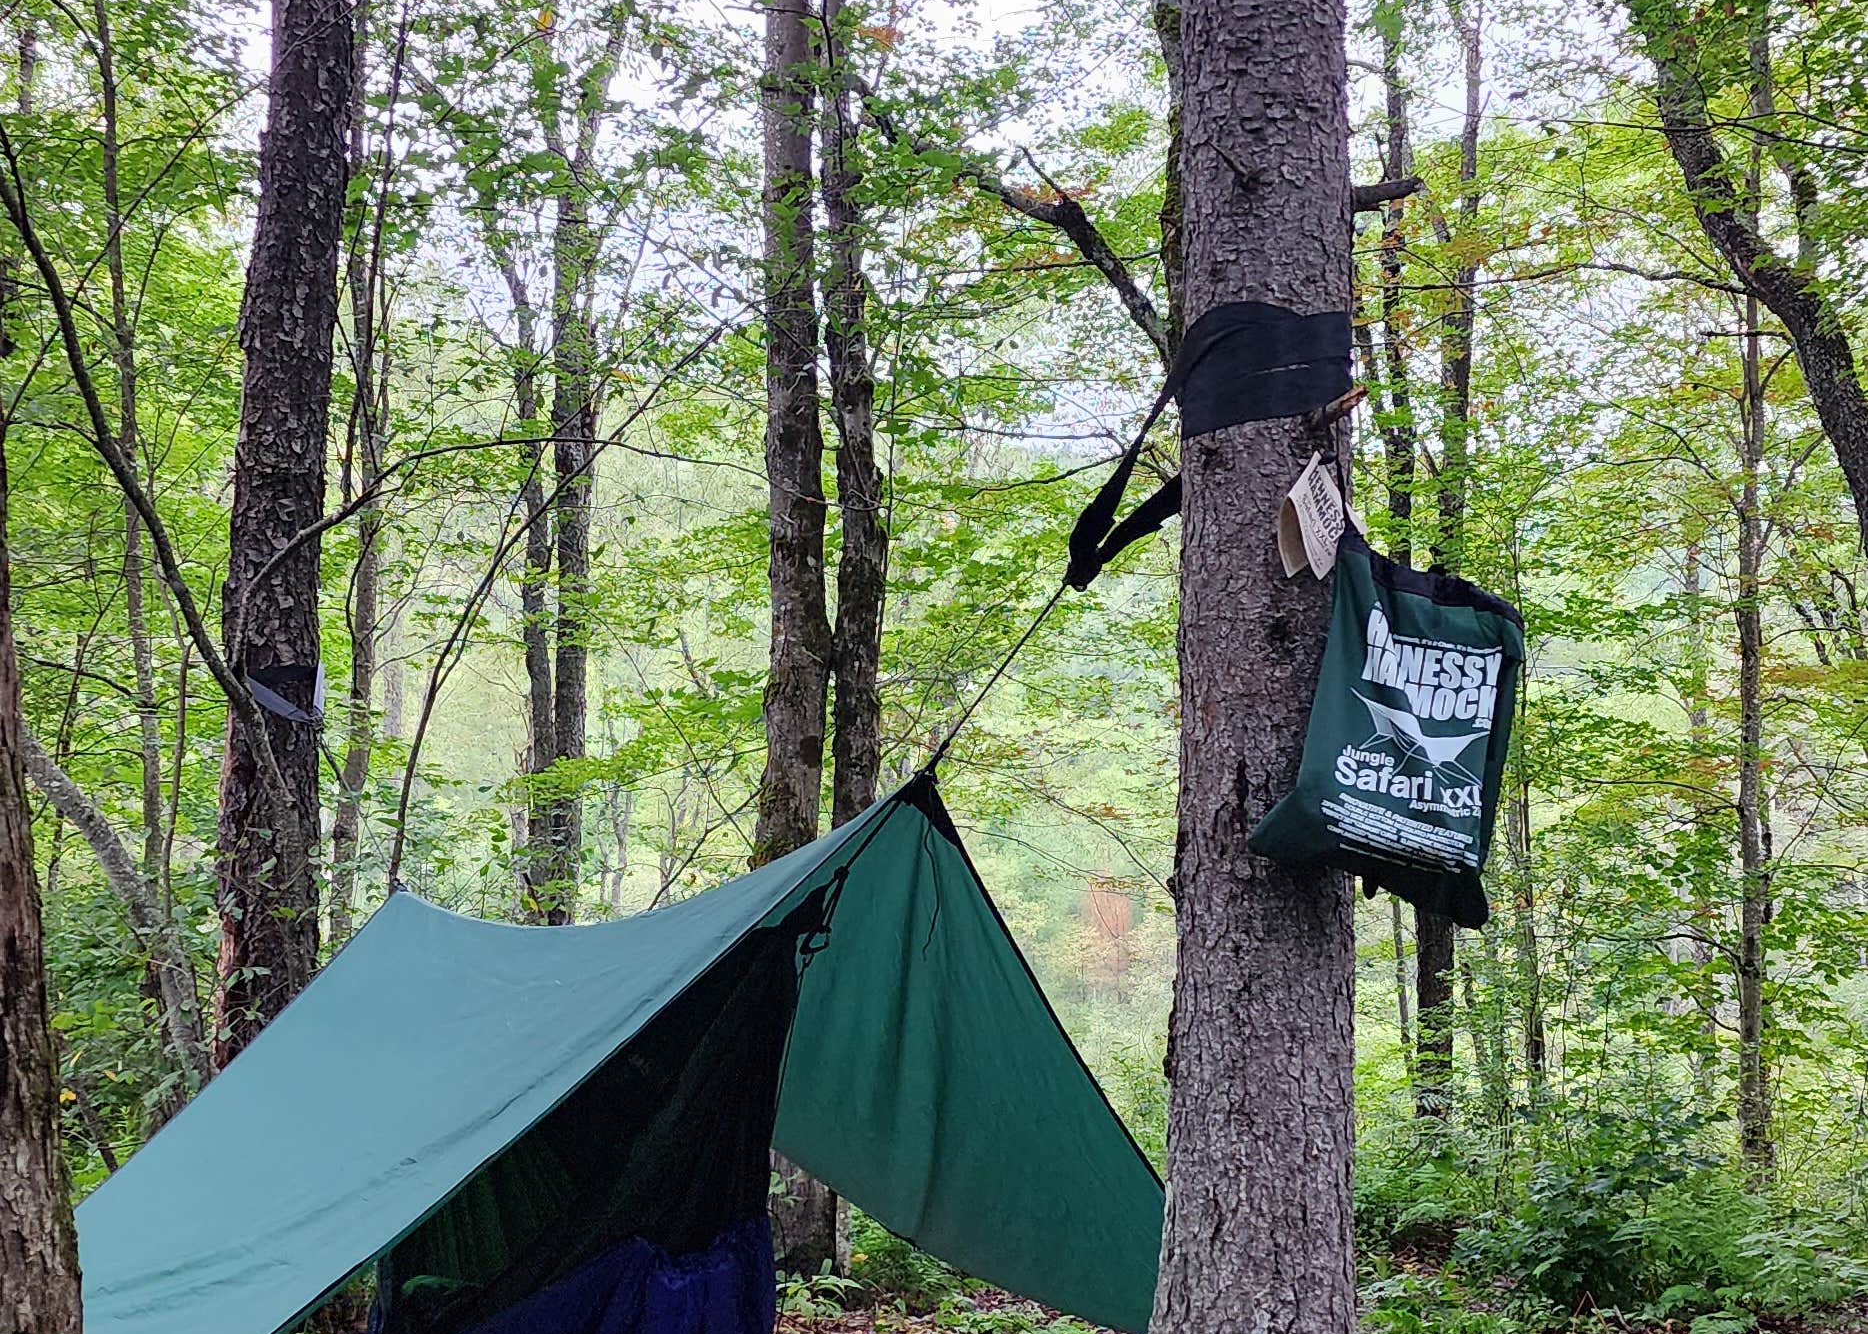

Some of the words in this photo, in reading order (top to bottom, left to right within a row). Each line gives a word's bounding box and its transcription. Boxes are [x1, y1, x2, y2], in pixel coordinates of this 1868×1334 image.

[1309, 467, 1345, 533] HENNESS
[1342, 744, 1395, 767] Jungle
[1334, 755, 1433, 800] Safari
[1409, 799, 1471, 818] Asymmtric
